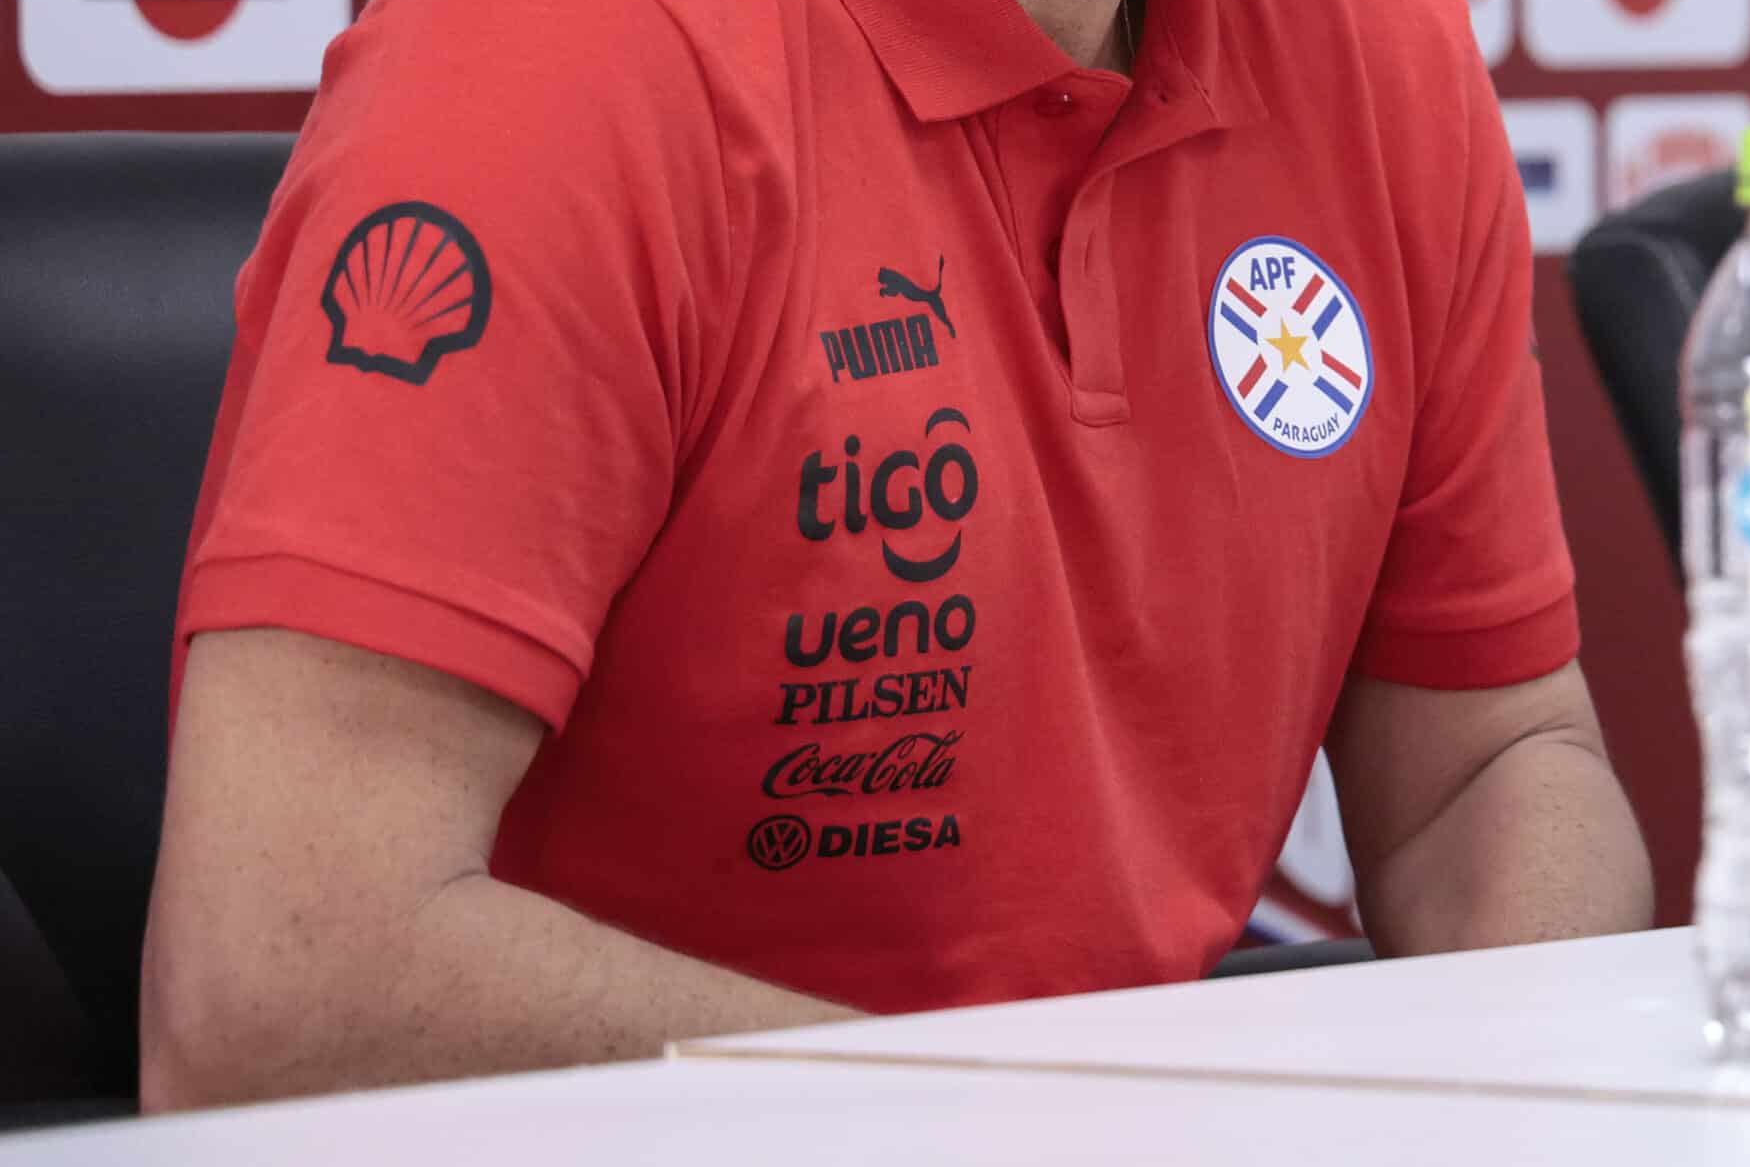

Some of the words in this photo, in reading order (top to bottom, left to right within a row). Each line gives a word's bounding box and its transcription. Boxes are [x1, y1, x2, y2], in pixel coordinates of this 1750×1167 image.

[1249, 256, 1297, 292] APF
[819, 314, 940, 383] PUMA
[1272, 412, 1341, 443] PARAGUAY
[796, 407, 979, 582] tigo
[785, 595, 975, 666] ueno
[774, 665, 972, 725] PILSEN
[816, 814, 961, 858] DIESA
